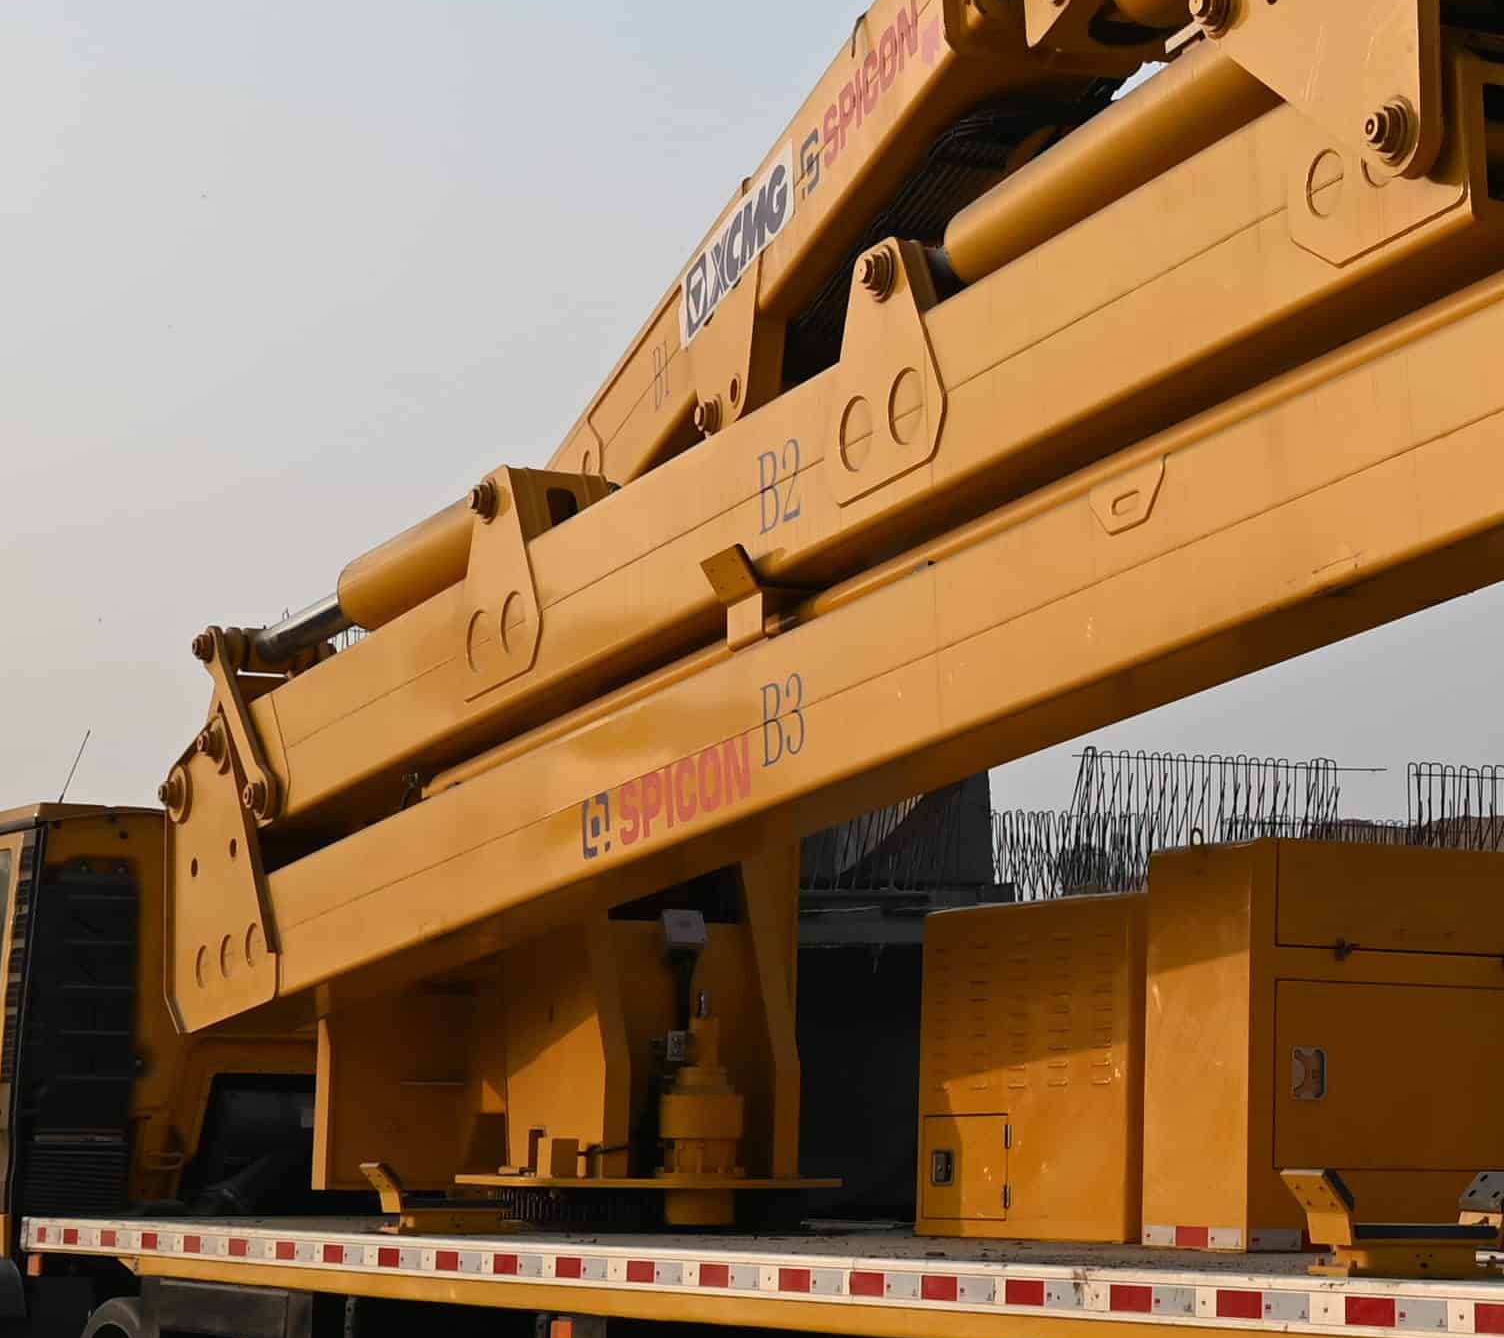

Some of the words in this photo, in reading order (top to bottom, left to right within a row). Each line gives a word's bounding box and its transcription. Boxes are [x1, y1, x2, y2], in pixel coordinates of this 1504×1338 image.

[709, 164, 788, 309] XCMG
[652, 340, 670, 413] B1
[758, 438, 801, 535] B2
[619, 732, 752, 846] SPICON
[760, 673, 805, 767] B3
